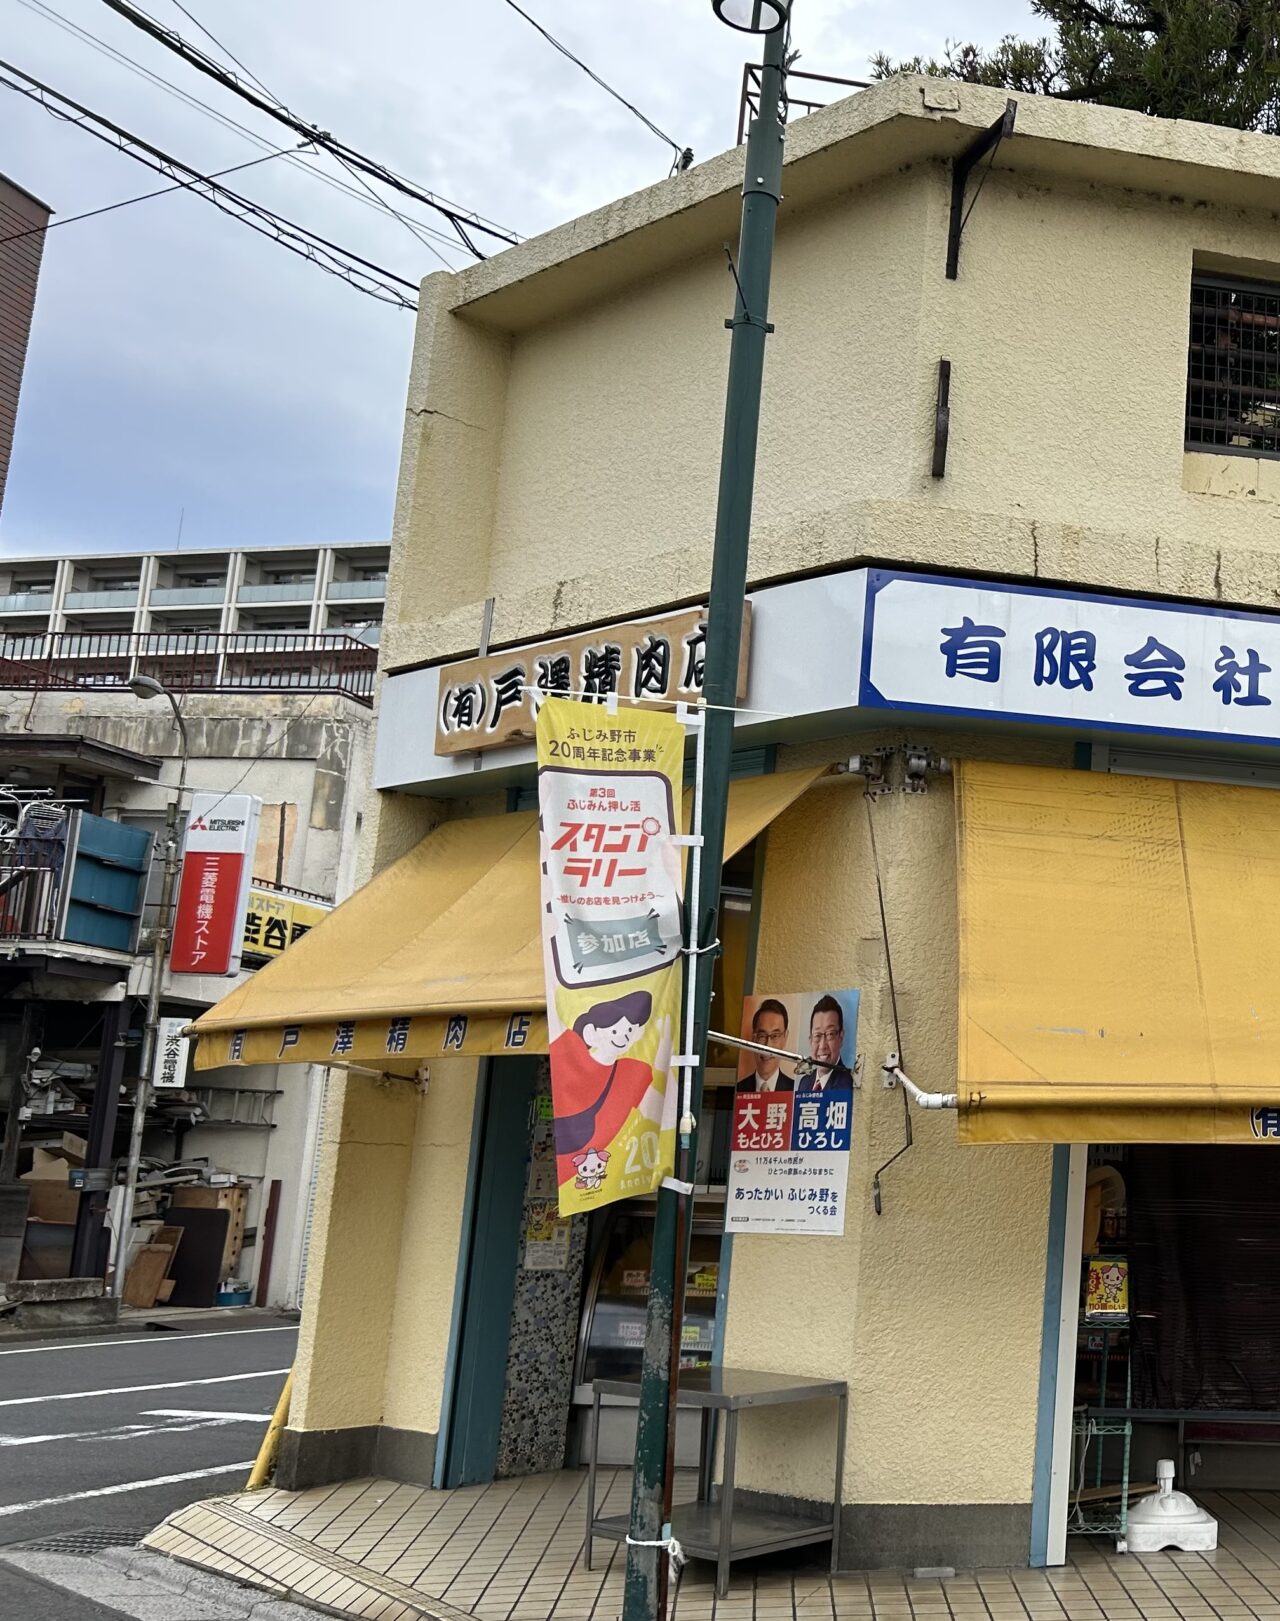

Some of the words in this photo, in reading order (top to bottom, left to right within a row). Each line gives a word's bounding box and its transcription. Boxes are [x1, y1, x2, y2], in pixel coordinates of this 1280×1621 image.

[940, 616, 1273, 707] 有限会社
[567, 728, 637, 743] ふじみ野市
[549, 740, 657, 763] 20周年記念事業
[590, 787, 616, 799] 第3回
[567, 800, 641, 812] ふじみん押し活
[551, 816, 662, 852] スタンプ
[562, 858, 648, 887] ラリー
[191, 856, 221, 966] 三菱電機ストア
[248, 895, 285, 914] ストア
[577, 929, 651, 954] 参加店
[160, 1035, 182, 1083] 渋谷電機
[737, 1102, 788, 1131] 大野
[798, 1101, 847, 1131] 高畑
[737, 1132, 784, 1149] もとひろ
[798, 1132, 843, 1149] ひろし
[624, 1131, 660, 1175] 20
[735, 1187, 784, 1201] あったかい
[788, 1187, 838, 1203] ふじみ野を
[808, 1205, 838, 1216] つくる会
[1089, 1271, 1097, 1292] SOS
